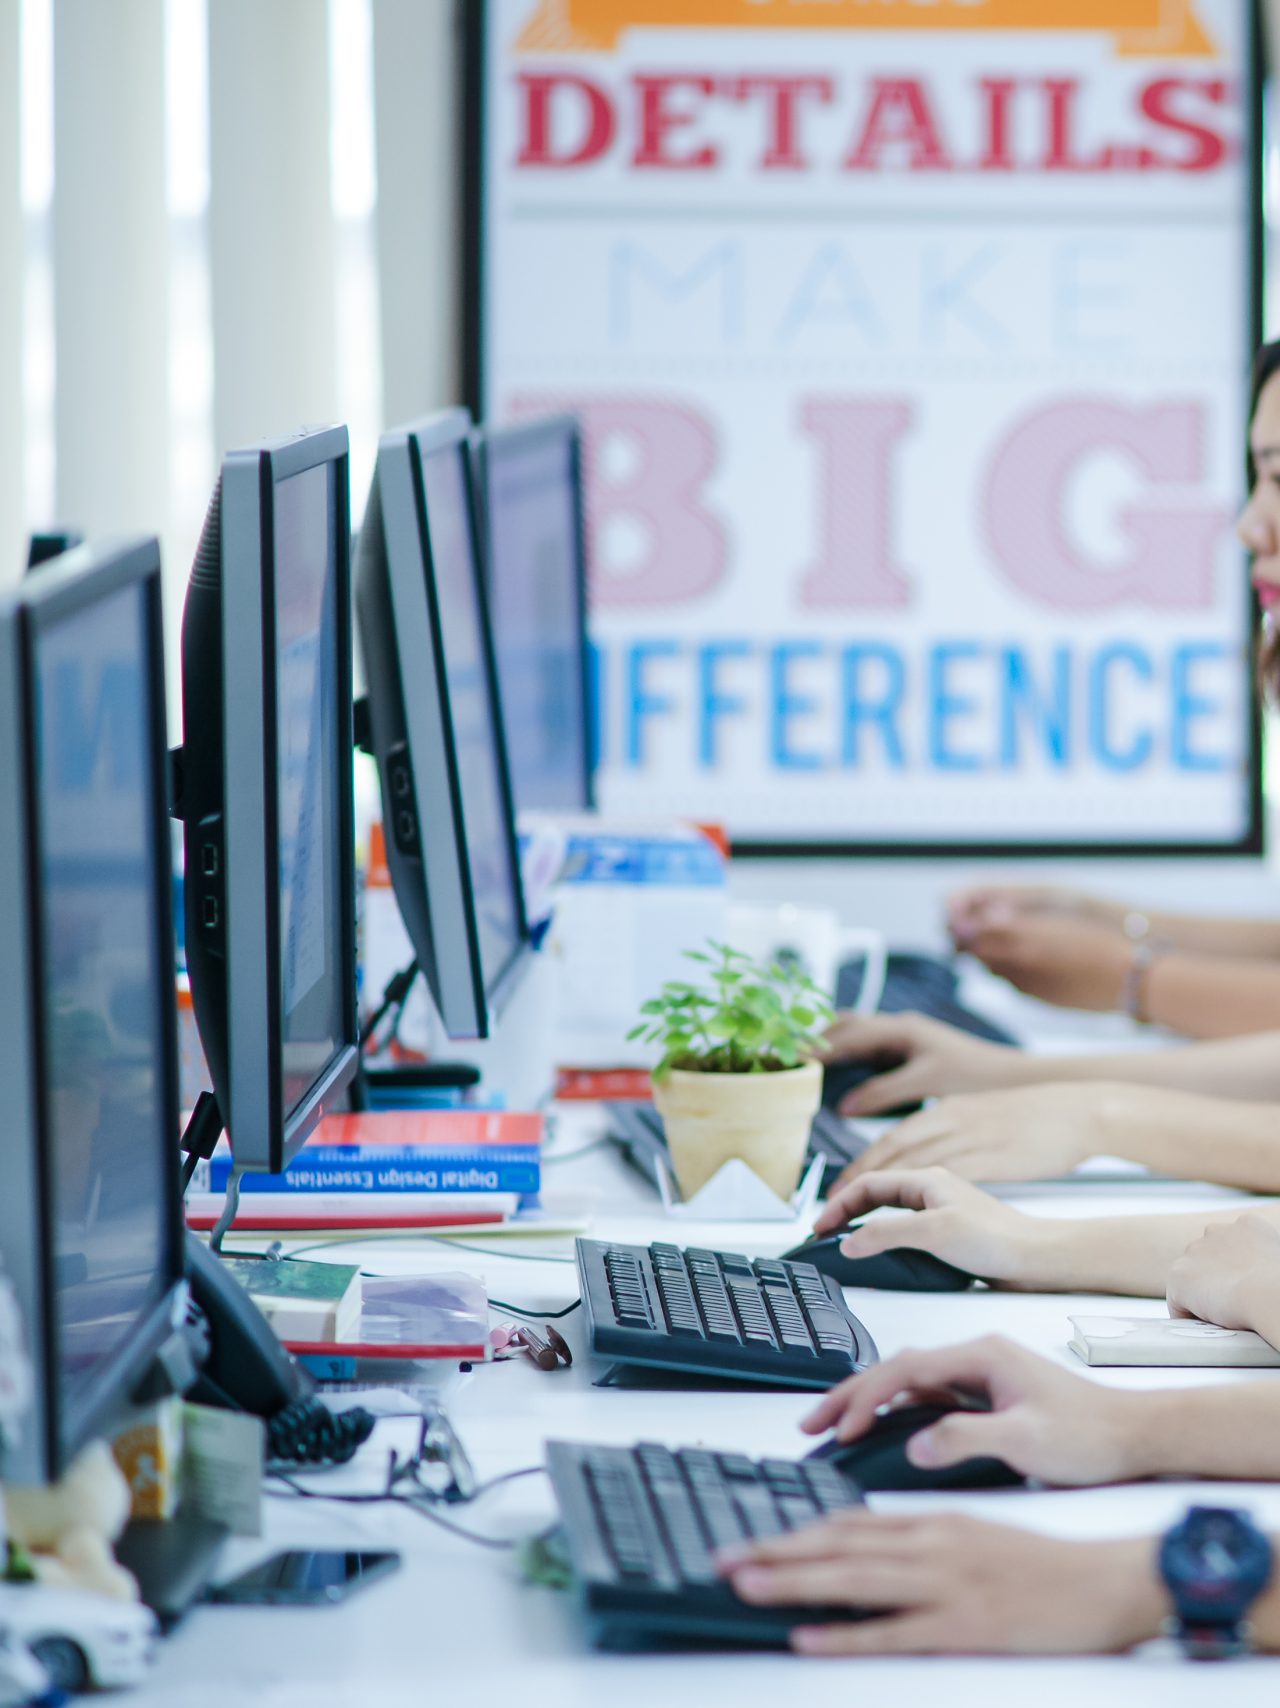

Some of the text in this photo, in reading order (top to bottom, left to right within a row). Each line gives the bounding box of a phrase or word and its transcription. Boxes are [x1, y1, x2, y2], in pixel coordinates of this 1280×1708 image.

[512, 70, 1238, 177] DETAILS
[605, 236, 1138, 356] MAKE
[508, 388, 1230, 613] BIG
[589, 638, 1233, 773] IFFERENCE
[285, 1168, 499, 1189] Digital Design Essentials
